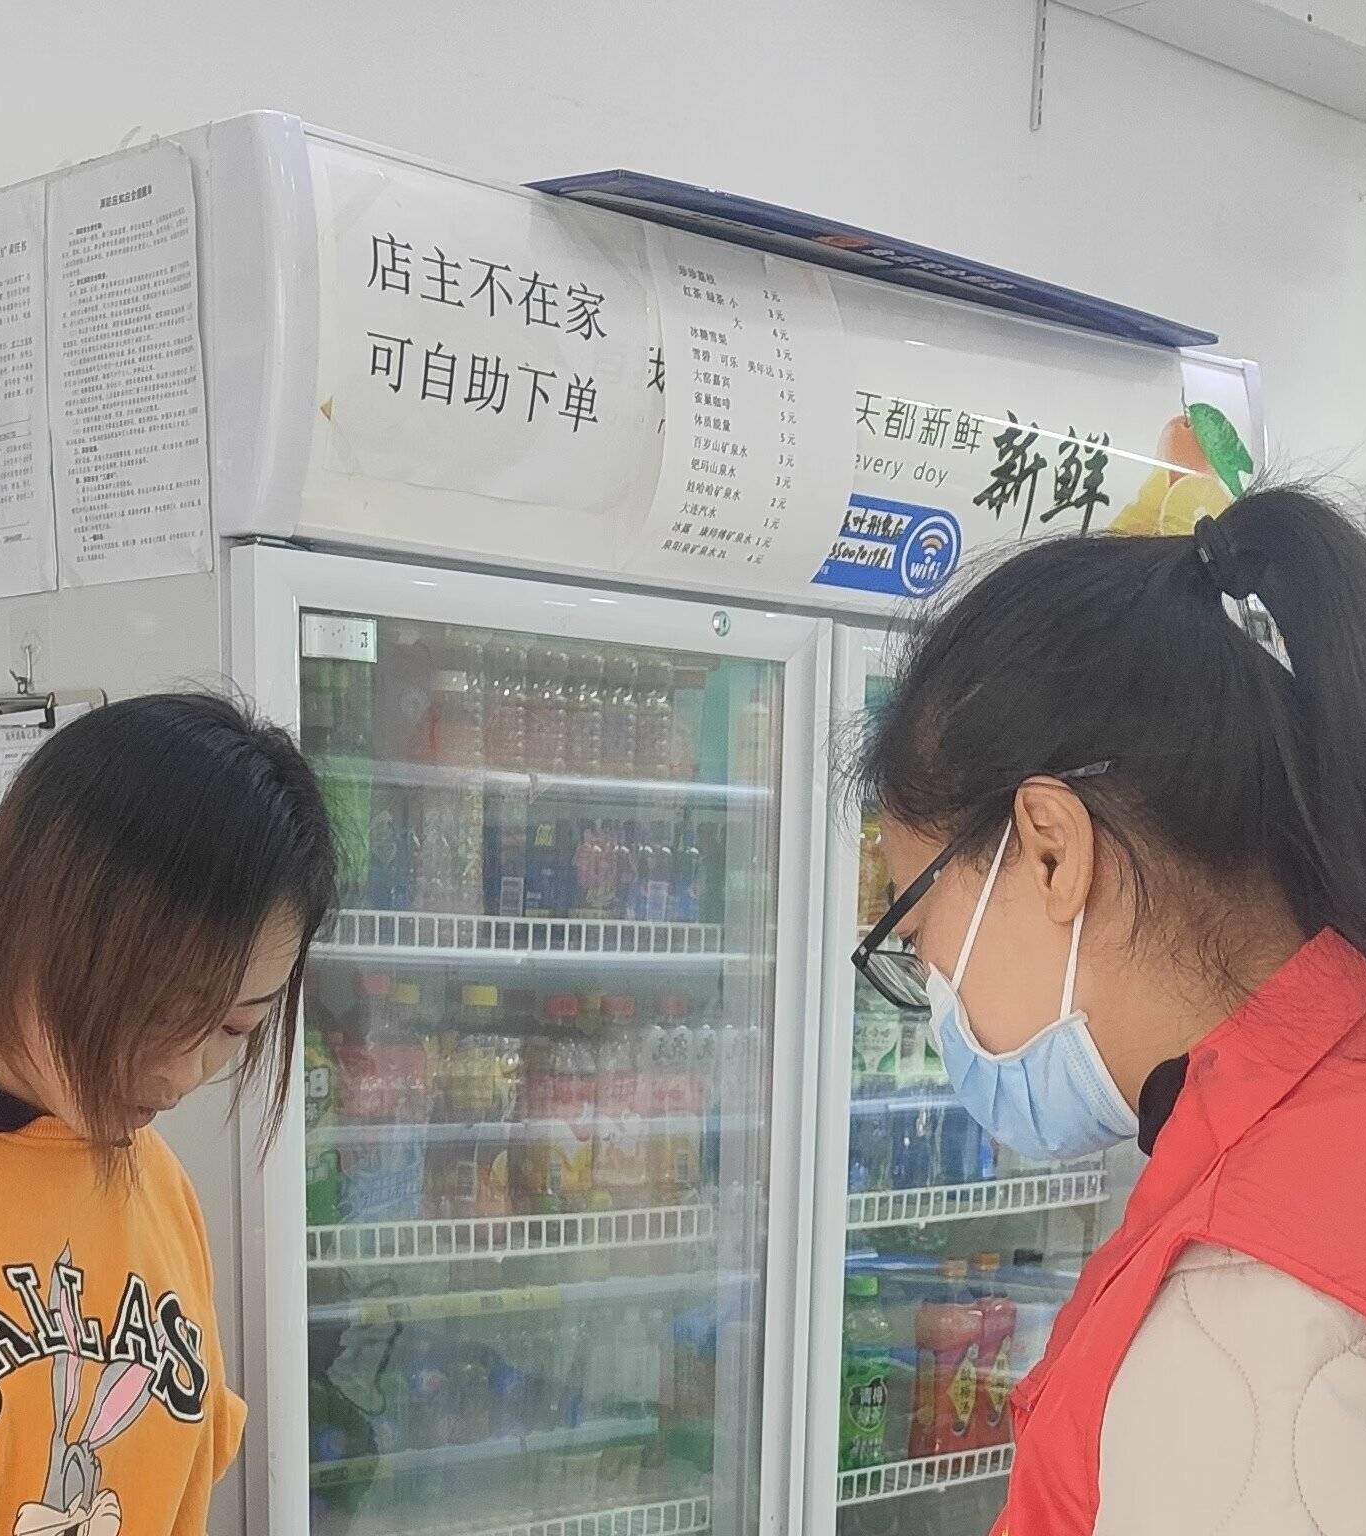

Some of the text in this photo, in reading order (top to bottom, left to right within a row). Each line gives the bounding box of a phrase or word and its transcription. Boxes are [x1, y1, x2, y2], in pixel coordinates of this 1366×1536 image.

[367, 231, 608, 341] 店主不在家
[366, 330, 599, 434] 可自助下单
[720, 354, 739, 369] 可乐
[693, 435, 748, 458] 百岁山矿泉水
[855, 390, 985, 455] 天都新鲜
[972, 409, 1110, 540] 新鲜
